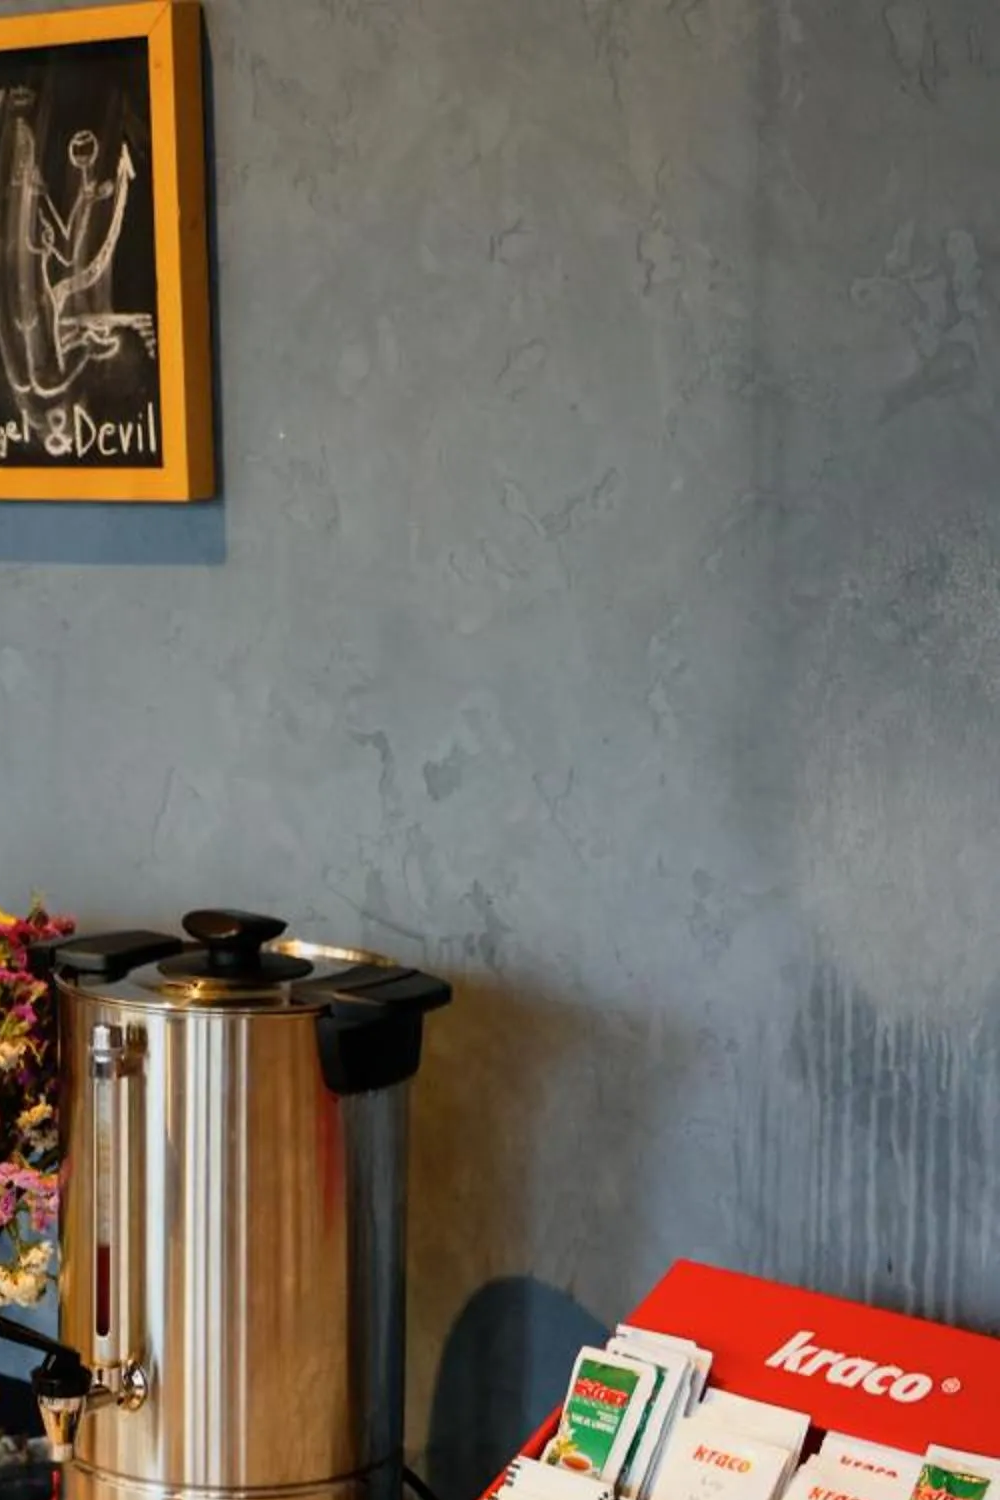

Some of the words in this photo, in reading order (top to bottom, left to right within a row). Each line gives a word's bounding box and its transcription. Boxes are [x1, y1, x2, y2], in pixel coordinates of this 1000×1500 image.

[74, 401, 157, 458] Devil
[764, 1330, 933, 1403] kraco
[692, 1444, 752, 1473] kraco
